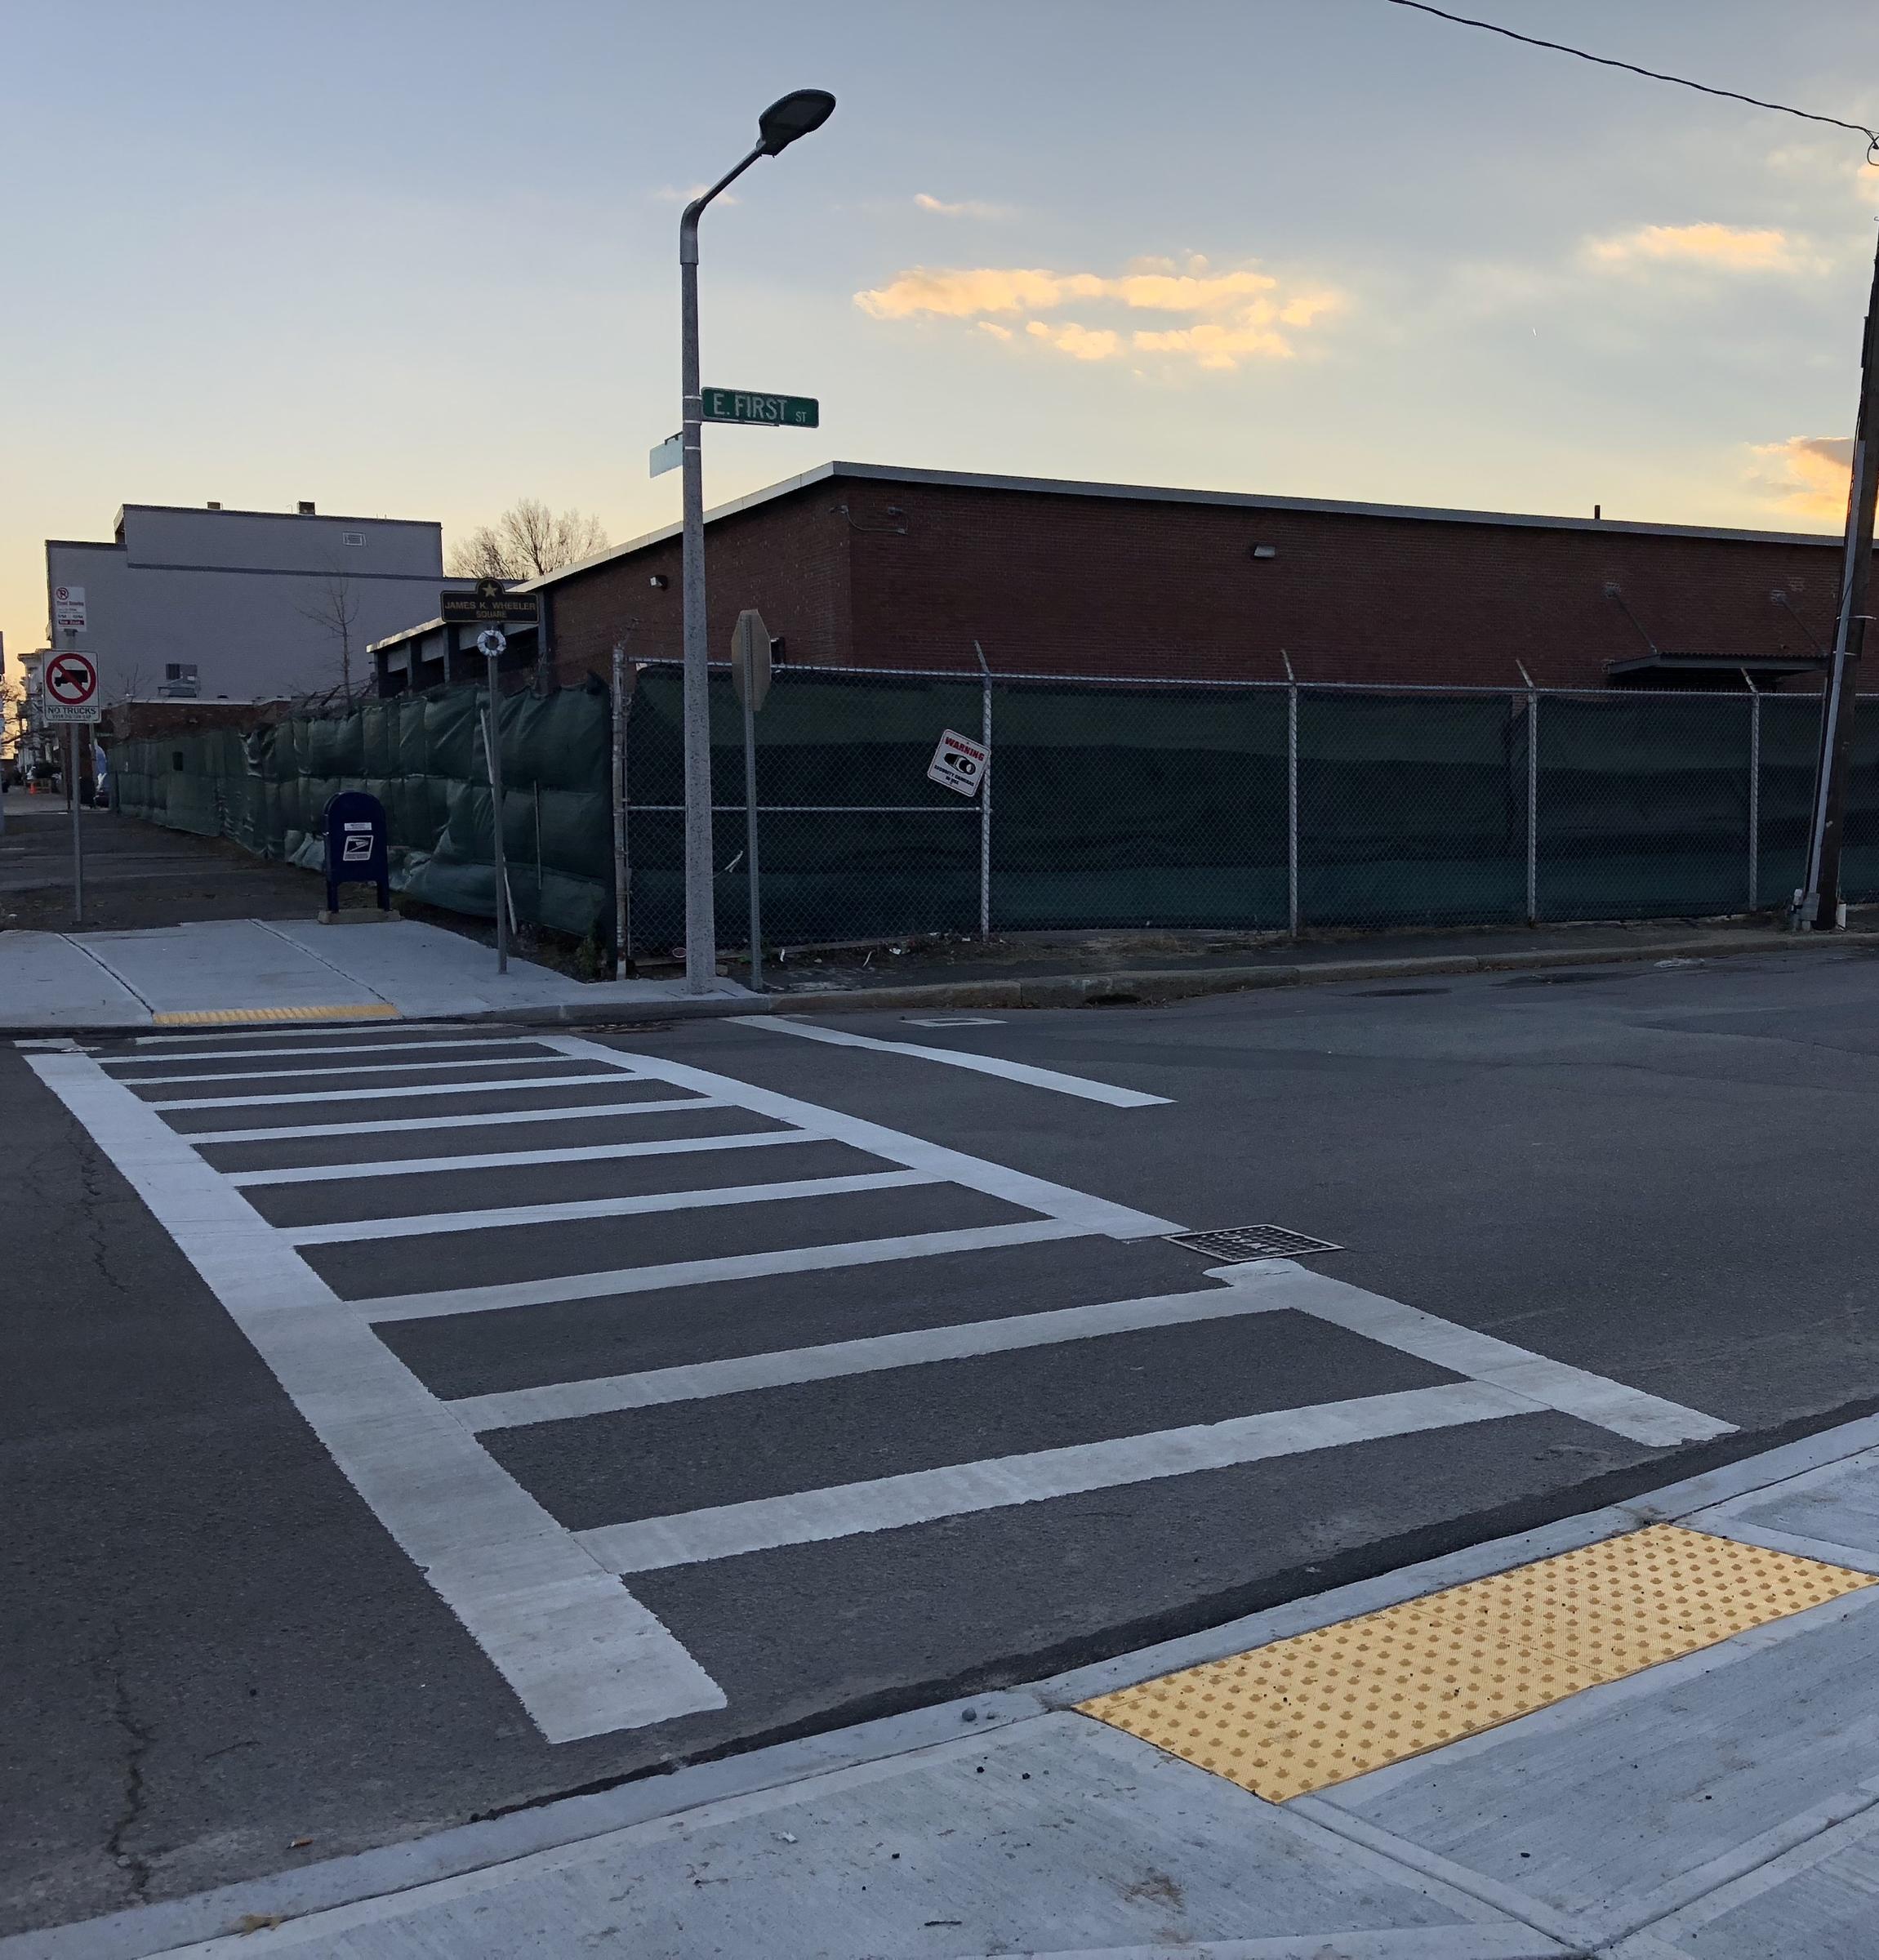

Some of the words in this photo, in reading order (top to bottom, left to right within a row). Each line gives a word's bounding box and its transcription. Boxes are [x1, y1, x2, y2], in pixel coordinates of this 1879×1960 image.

[714, 393, 730, 415] E.
[735, 395, 787, 420] FIRST
[795, 411, 807, 423] ST
[444, 601, 476, 609] JAMES
[492, 602, 536, 611] WHEELER
[945, 737, 985, 761] WARNING
[934, 764, 955, 777] SECURITY
[955, 773, 975, 786] CAMERAS
